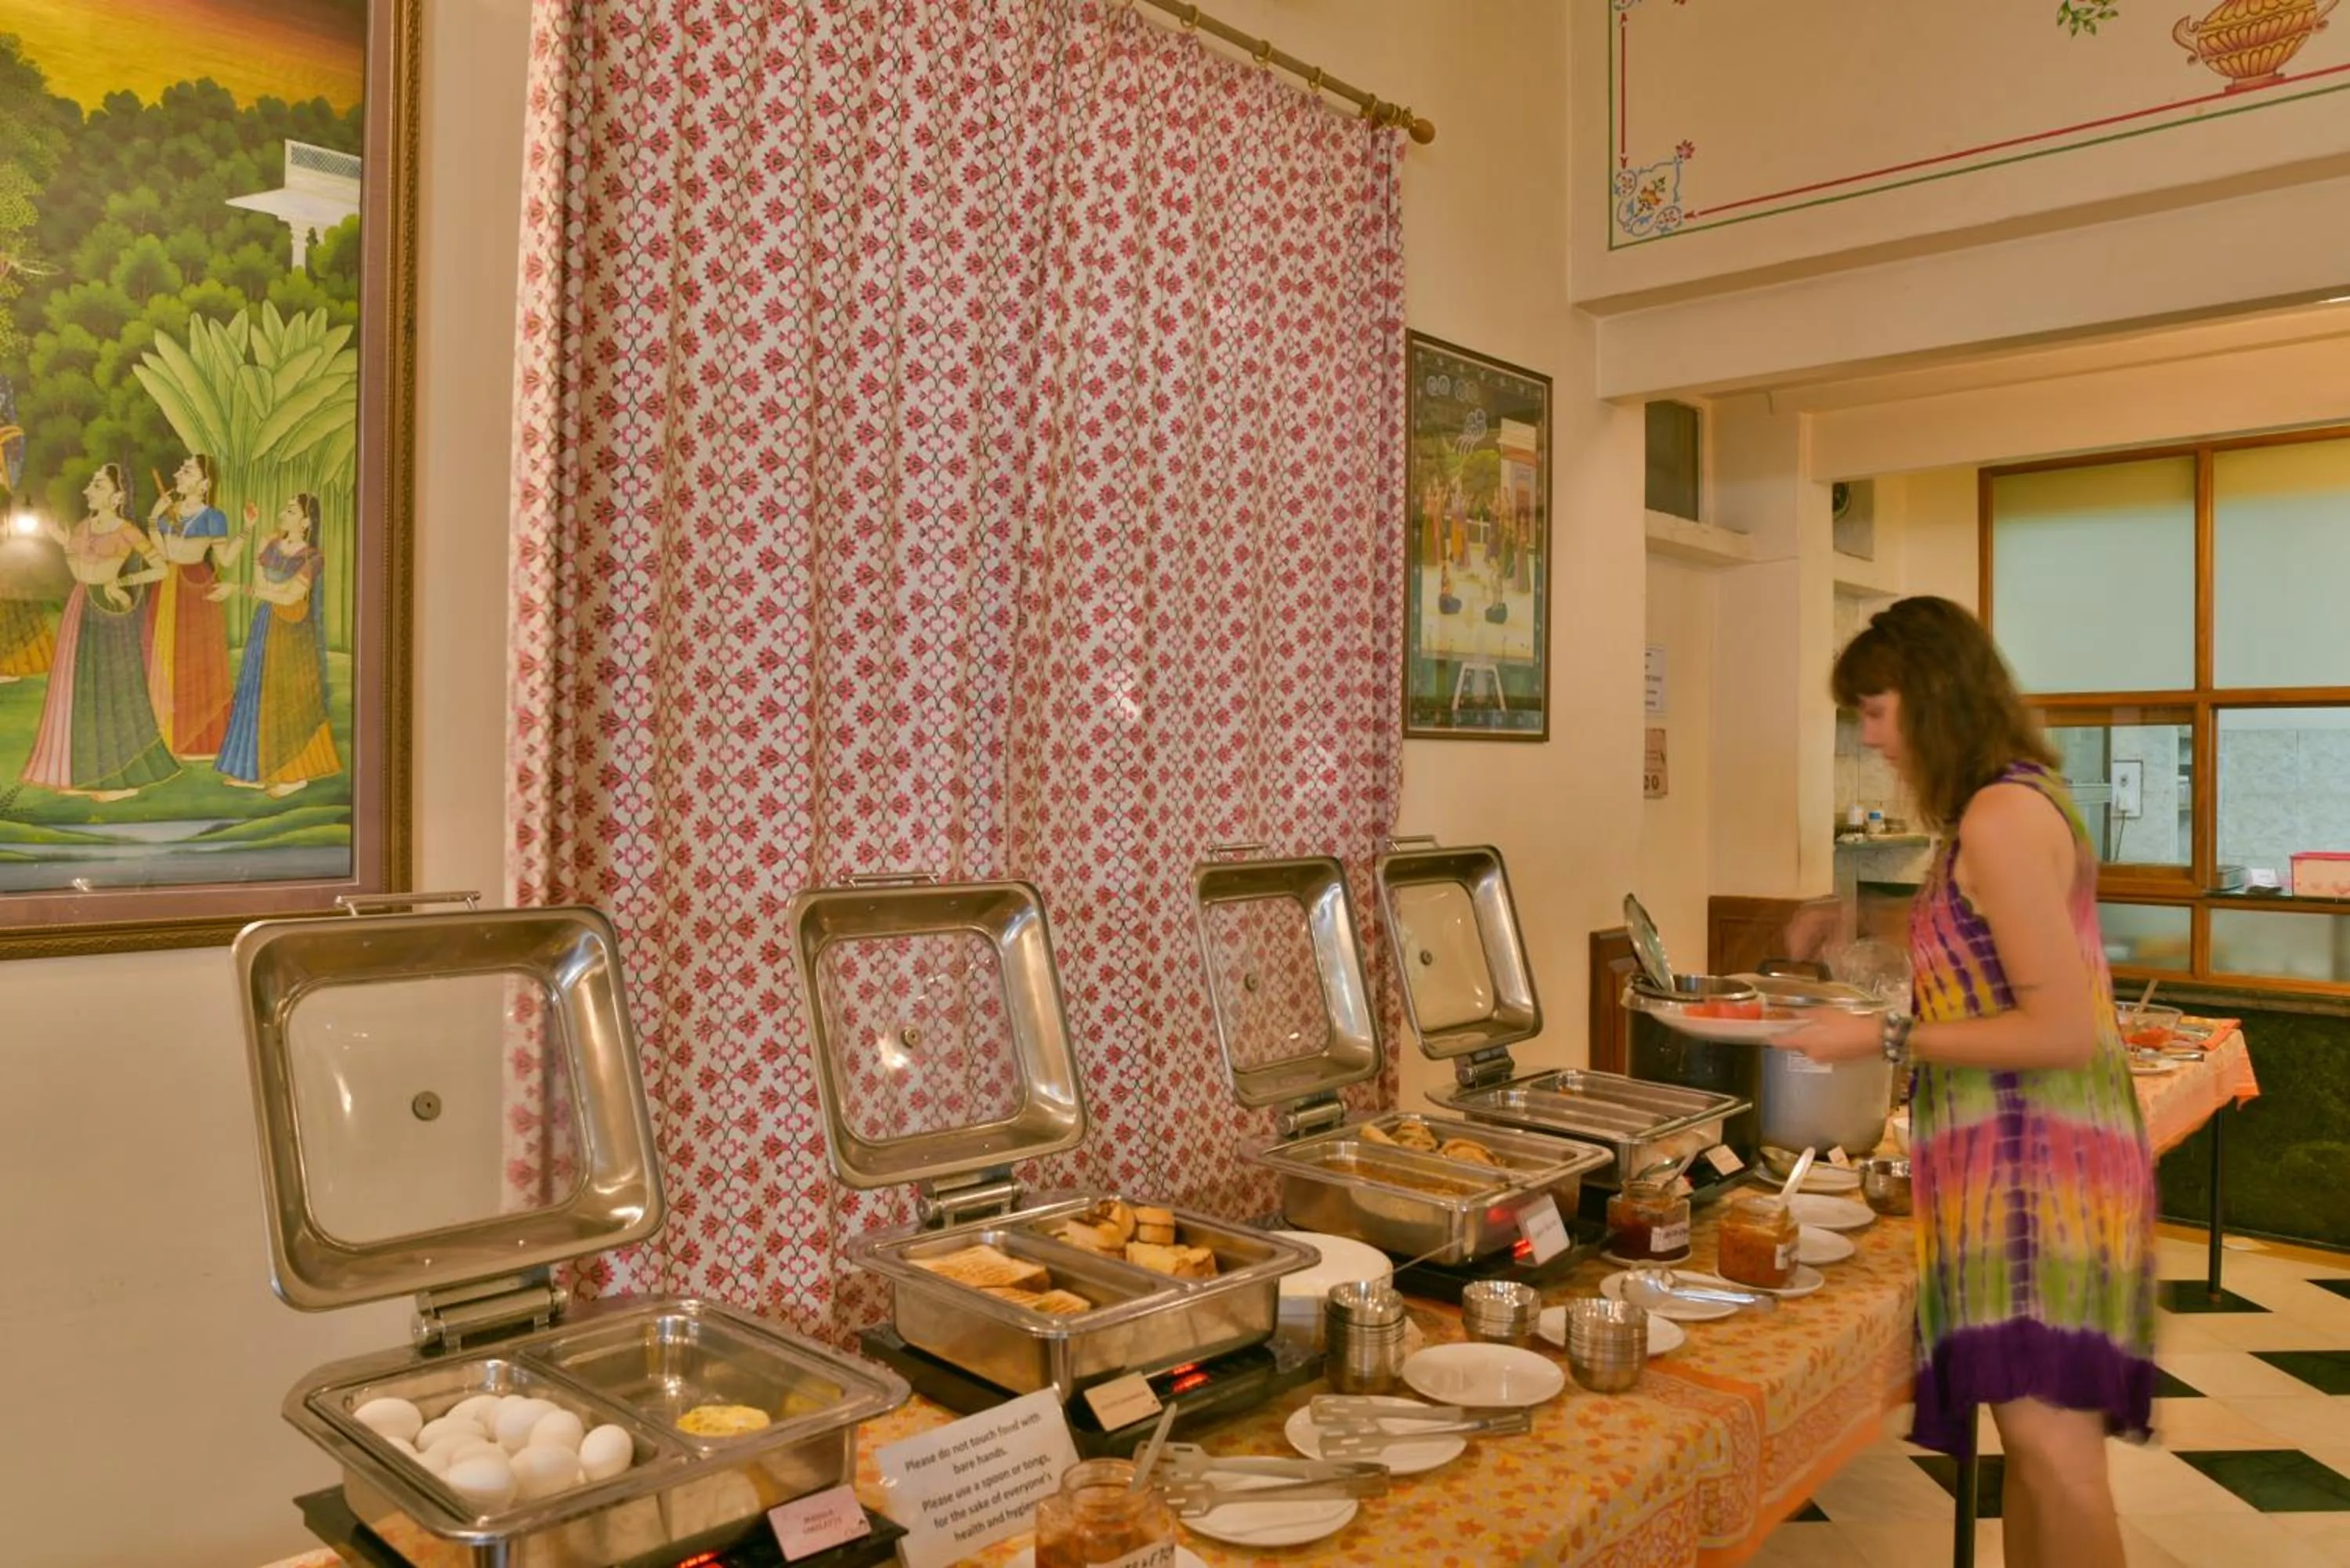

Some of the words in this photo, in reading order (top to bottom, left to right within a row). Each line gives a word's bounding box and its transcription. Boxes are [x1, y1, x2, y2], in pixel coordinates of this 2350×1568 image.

[904, 1454, 936, 1472] Please
[938, 1447, 951, 1459] do
[953, 1440, 968, 1454] not
[970, 1429, 997, 1447] touch
[998, 1421, 1020, 1434] food
[1021, 1413, 1040, 1425] with
[953, 1459, 976, 1475] bare
[977, 1447, 1007, 1463] hands.
[921, 1493, 954, 1512] Please
[955, 1486, 972, 1500] use
[974, 1481, 981, 1491] a
[982, 1471, 1010, 1489] spoon
[1012, 1465, 1021, 1476] or
[934, 1514, 949, 1530] for
[950, 1505, 967, 1522] the
[968, 1498, 990, 1515] sake
[992, 1490, 1003, 1505] of
[954, 1522, 987, 1542] health
[988, 1512, 1006, 1528] and
